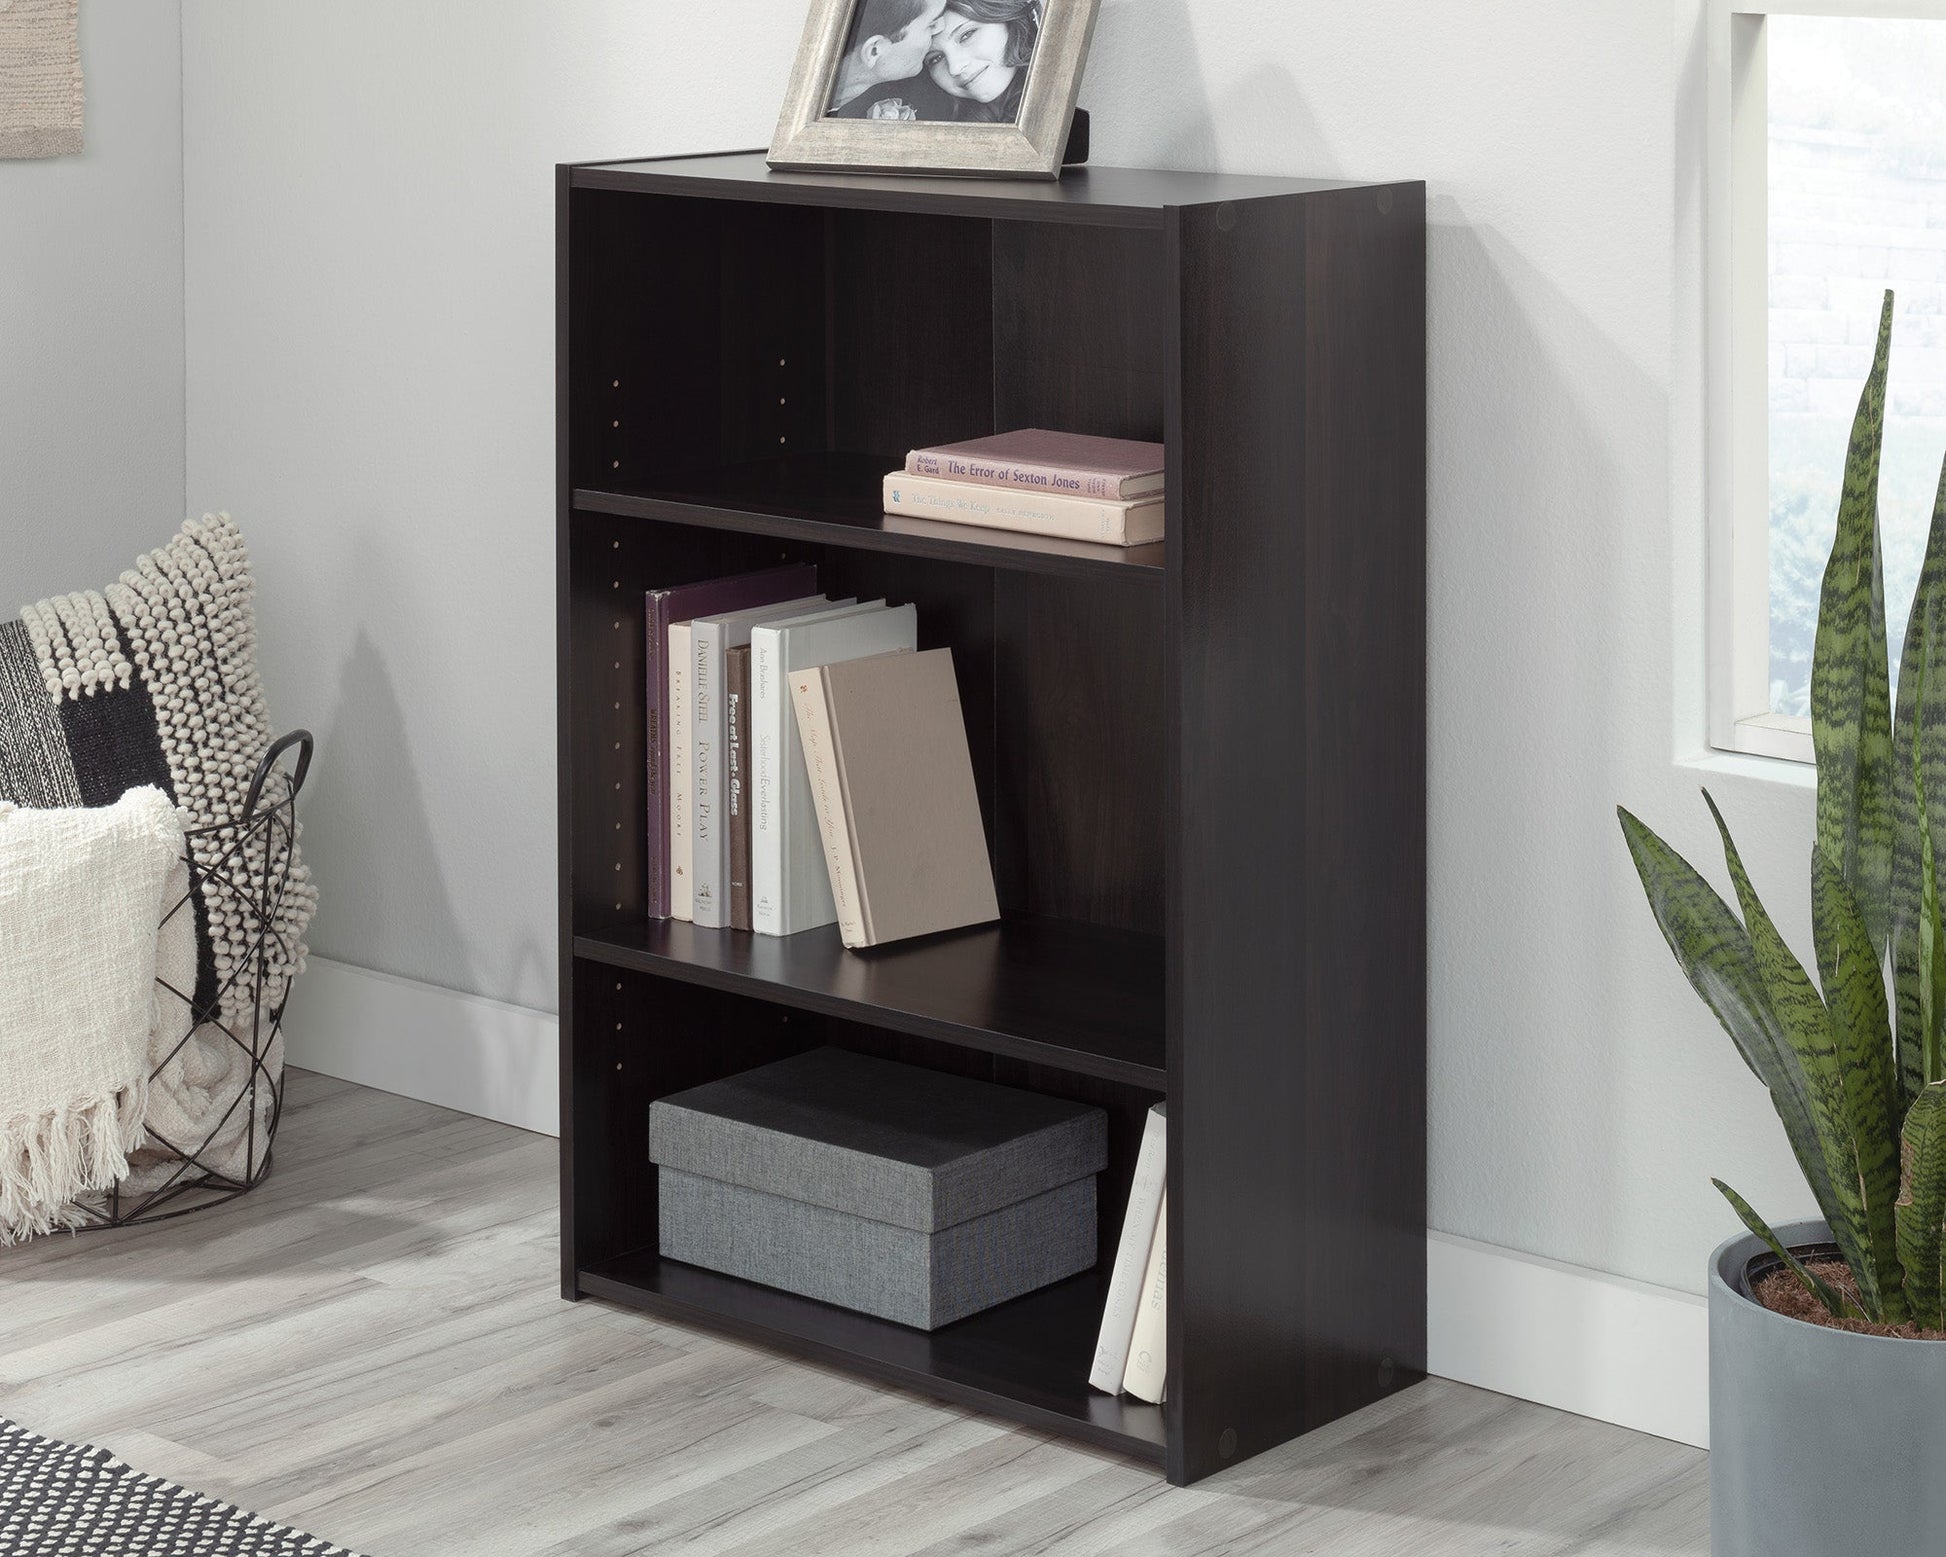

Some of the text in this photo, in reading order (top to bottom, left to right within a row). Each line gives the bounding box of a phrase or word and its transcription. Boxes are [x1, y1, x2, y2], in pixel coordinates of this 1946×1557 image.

[924, 465, 940, 475] Gard
[947, 460, 966, 475] The
[969, 463, 995, 479] Error
[998, 468, 1010, 480] of
[1013, 468, 1048, 486] Sexton
[1051, 474, 1081, 490] Jones
[698, 639, 710, 724] DANIELLE STEEL
[759, 647, 769, 699] Ann Brashares
[729, 693, 741, 816] Free at Last Glass
[699, 741, 711, 842] POWER PLAY
